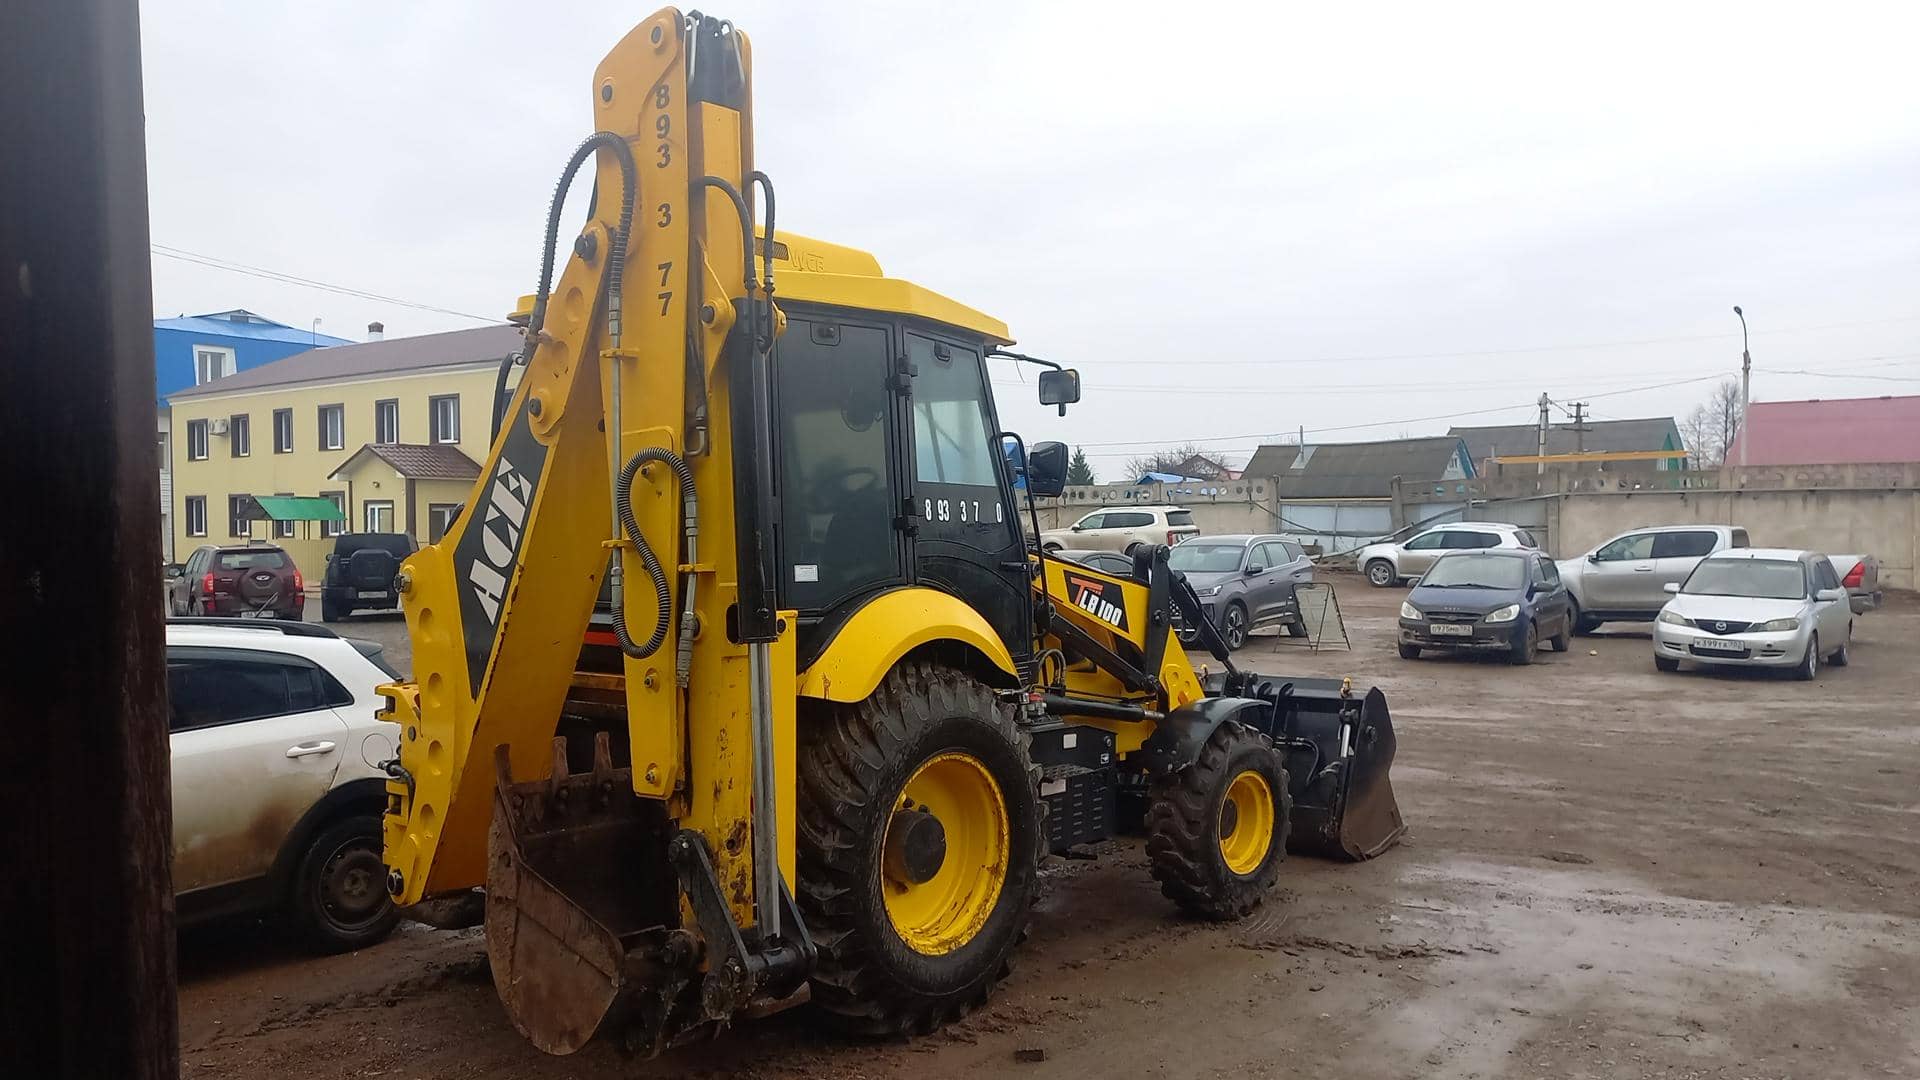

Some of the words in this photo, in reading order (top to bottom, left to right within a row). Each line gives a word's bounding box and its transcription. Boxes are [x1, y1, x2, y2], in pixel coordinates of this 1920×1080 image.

[960, 501, 967, 522] 3
[973, 501, 979, 522] 7
[996, 502, 1003, 523] 0
[470, 456, 532, 626] ACE
[1097, 599, 1123, 626] 100
